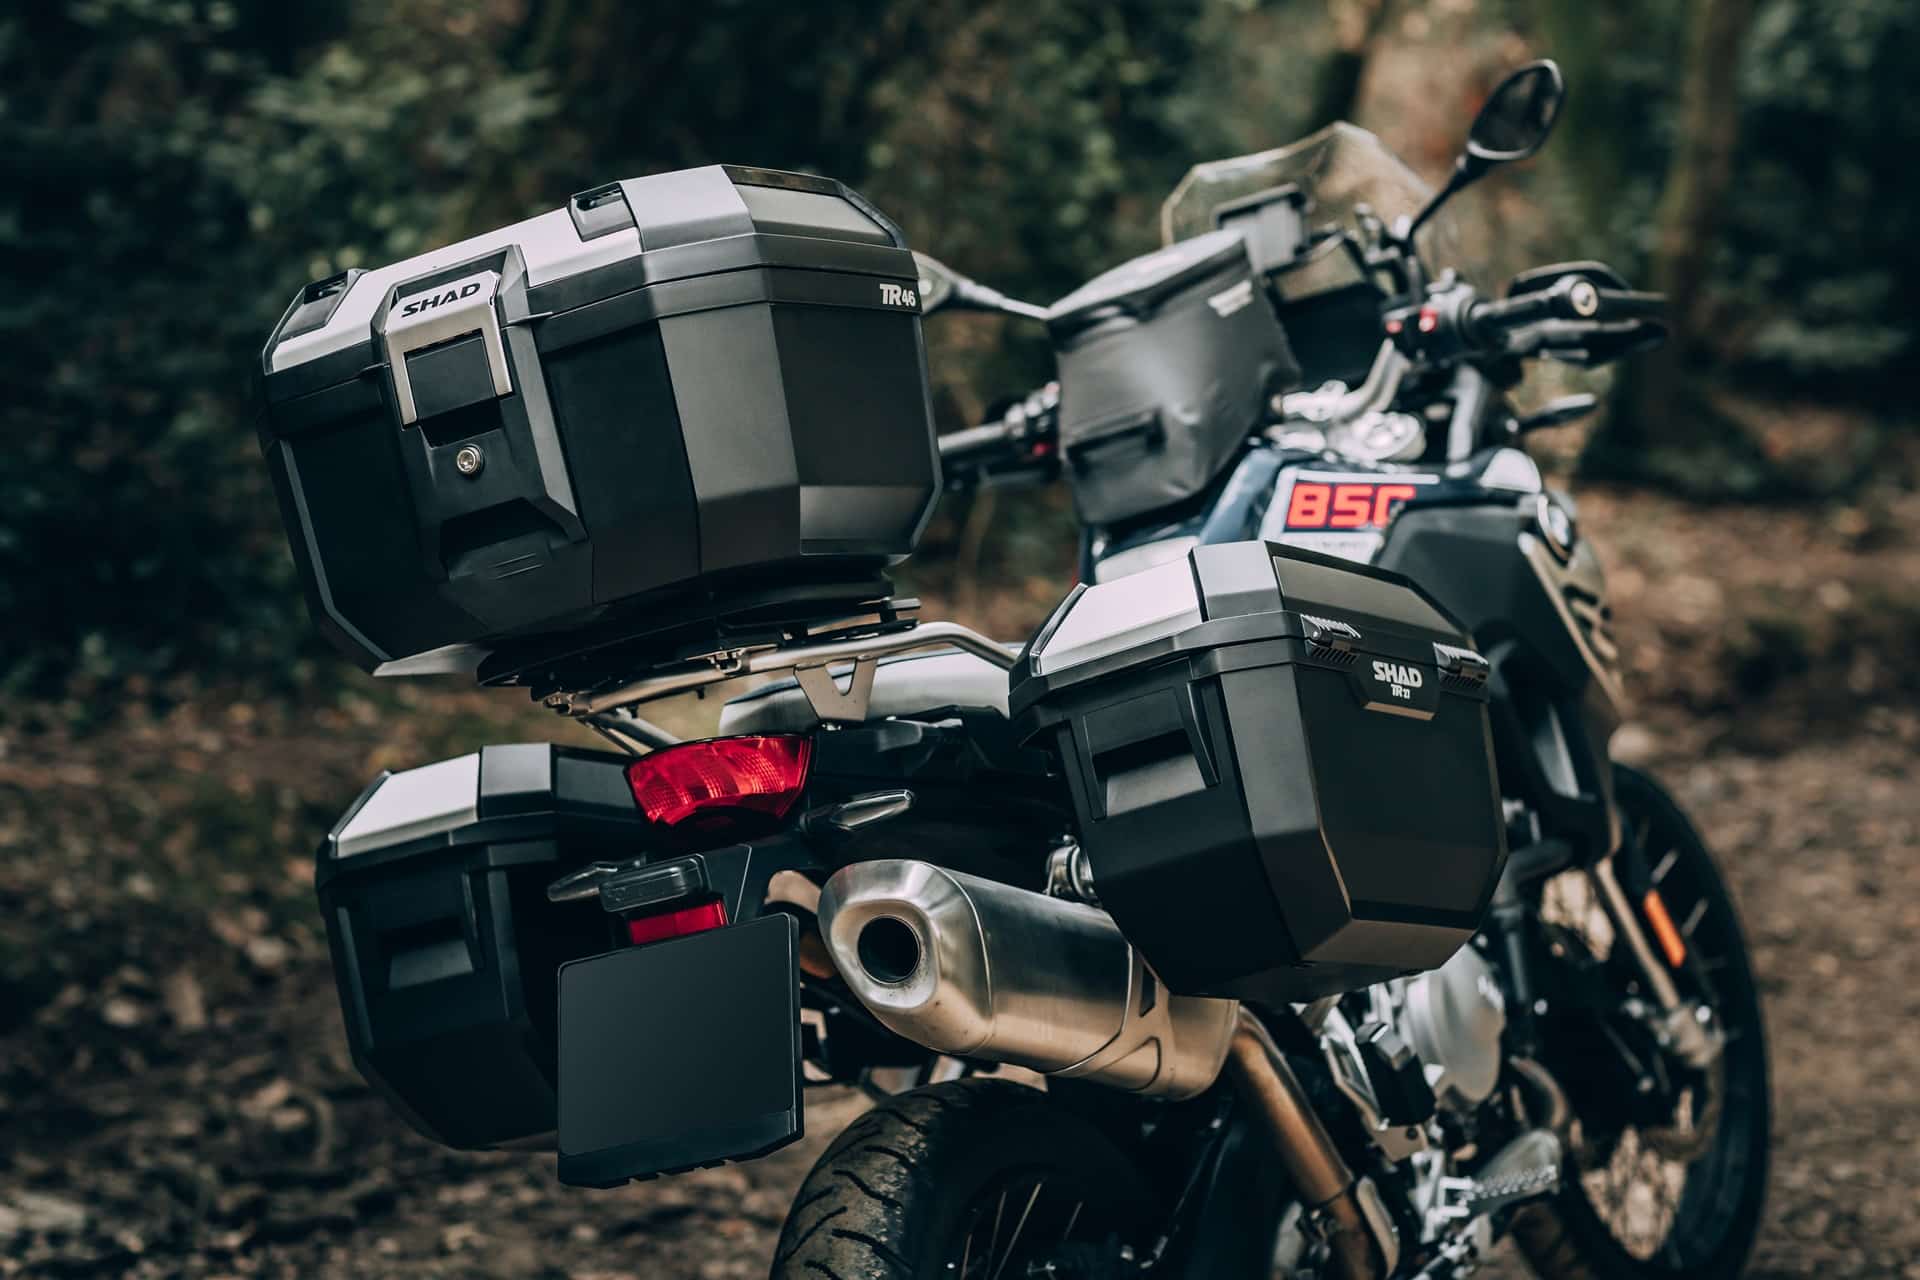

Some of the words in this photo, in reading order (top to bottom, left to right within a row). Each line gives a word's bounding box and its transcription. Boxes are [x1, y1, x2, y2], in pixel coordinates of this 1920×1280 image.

[401, 283, 481, 318] SHAD
[880, 283, 916, 307] TR46
[1372, 660, 1423, 688] SHAD
